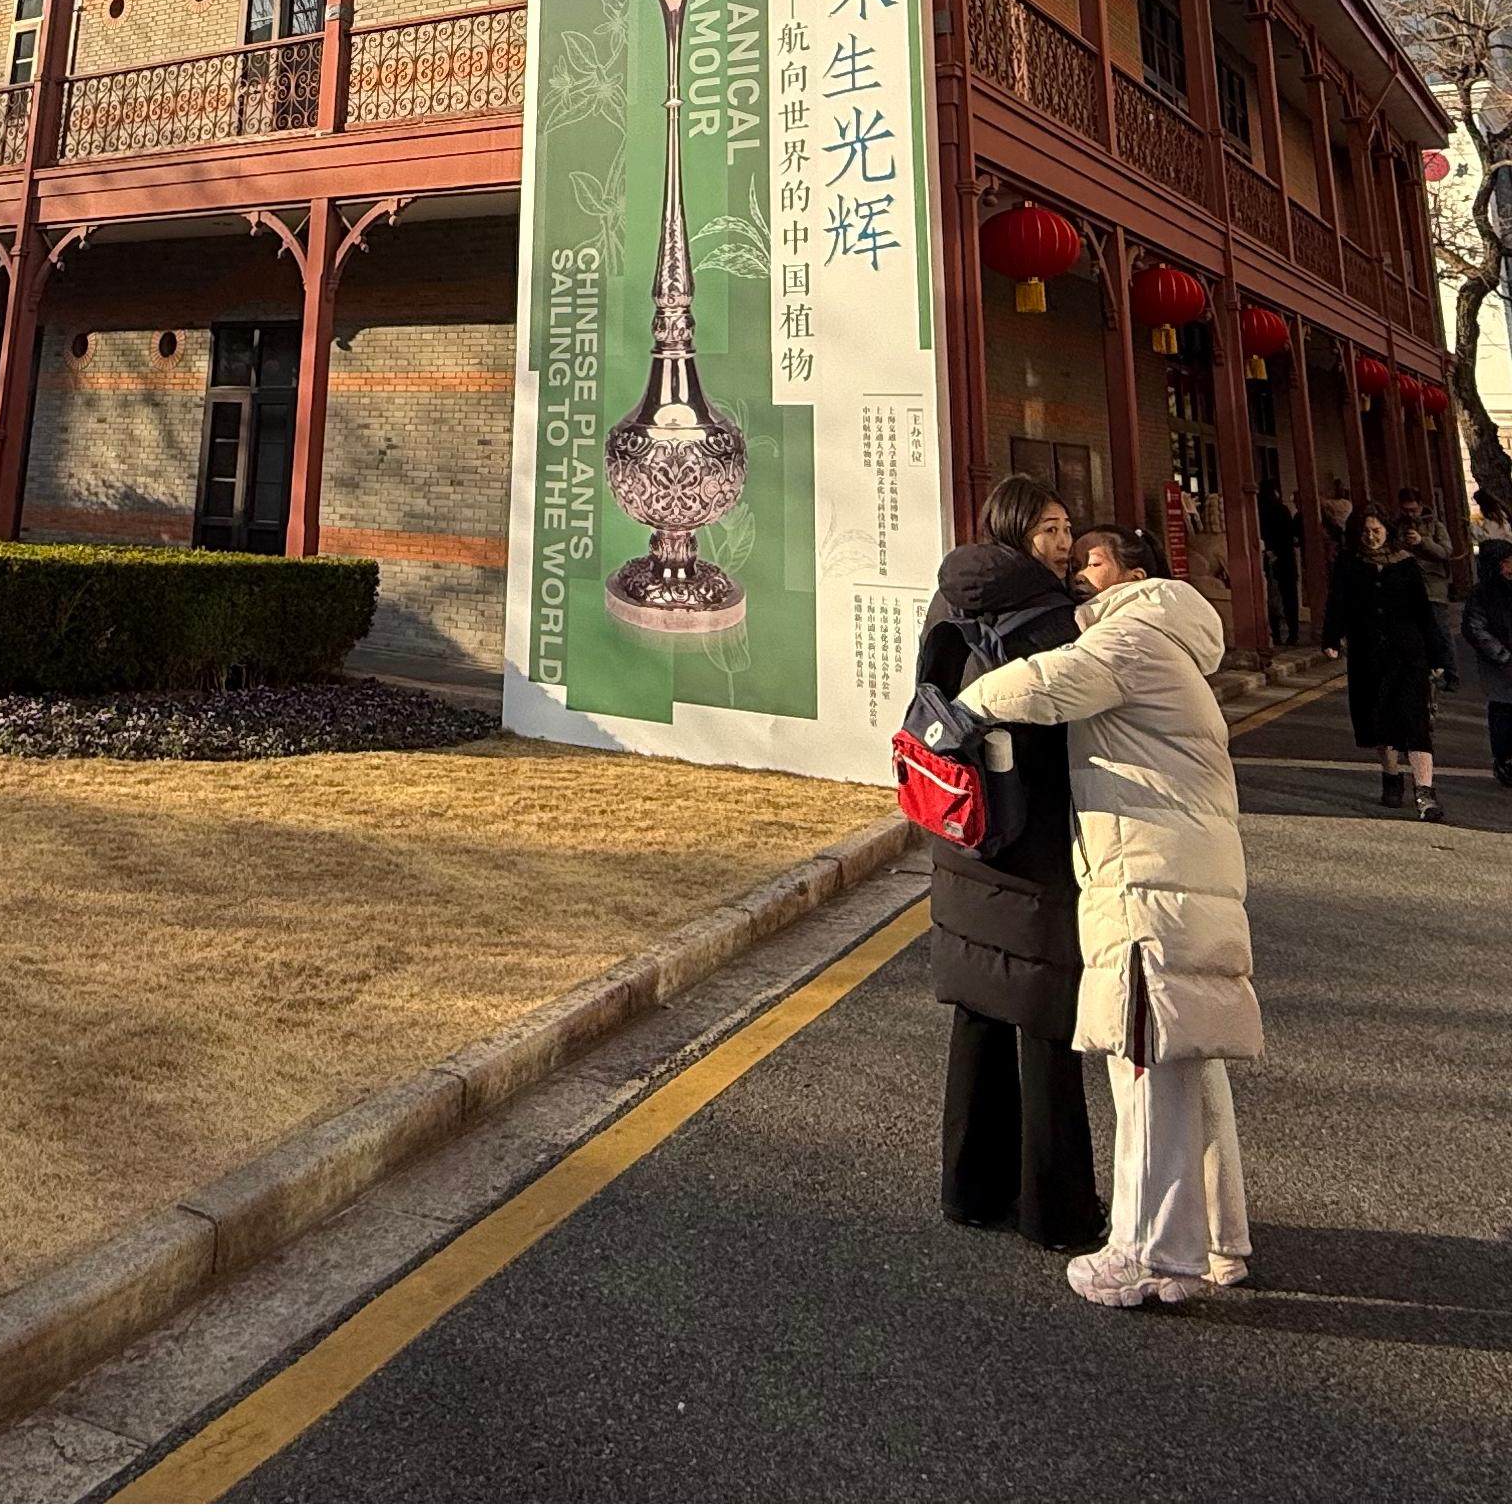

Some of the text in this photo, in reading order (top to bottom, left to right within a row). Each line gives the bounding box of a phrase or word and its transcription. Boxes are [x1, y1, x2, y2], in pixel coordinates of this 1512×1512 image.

[538, 249, 574, 684] SAILING TO THE WORLD
[569, 247, 600, 559] CHINESE PLANTS
[910, 414, 923, 463] 主办单位
